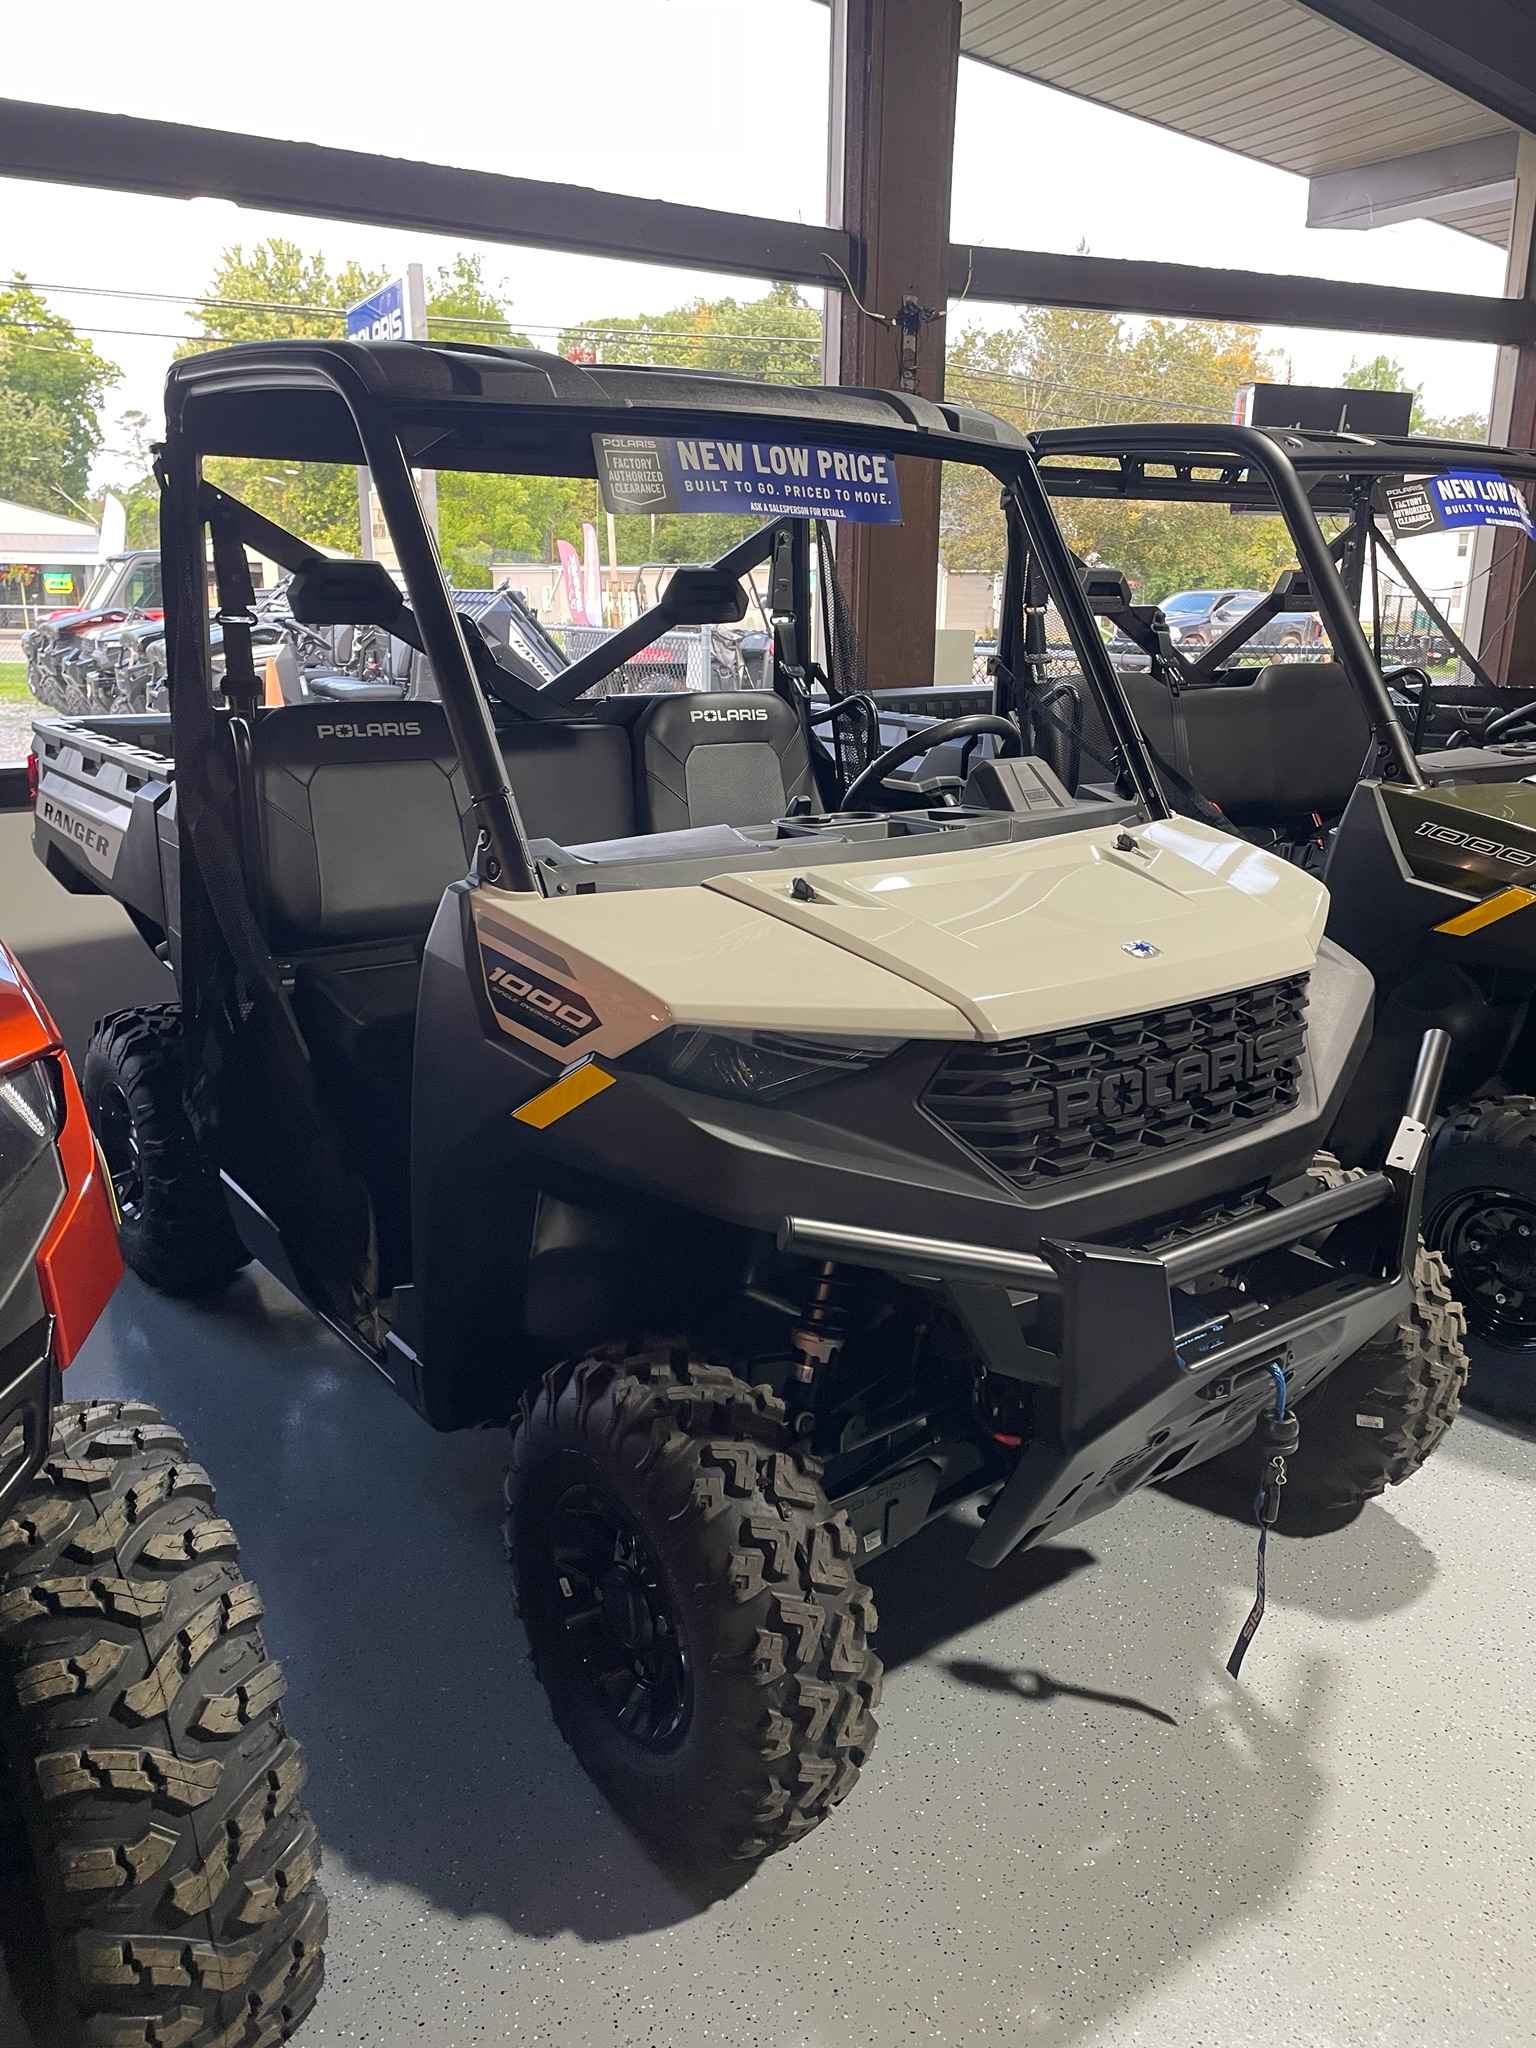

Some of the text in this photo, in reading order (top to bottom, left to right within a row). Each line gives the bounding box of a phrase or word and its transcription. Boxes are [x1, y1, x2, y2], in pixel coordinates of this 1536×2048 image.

[602, 438, 656, 449] POLARIS
[612, 457, 652, 470] FACTORY
[677, 441, 889, 484] NEW LOW PRICE
[608, 470, 664, 482] AUTHORIZED
[614, 483, 662, 494] CLEARANCE
[684, 480, 892, 505] BUILT TO GO. PRICED TO MOVE.
[1386, 484, 1424, 496] POLARIS
[1436, 479, 1477, 500] NEW
[1476, 480, 1509, 502] LOW
[750, 502, 847, 519] ASK A SALESPERSON FOR DETAILS.
[1393, 504, 1431, 518] AUTHORIZED
[1394, 497, 1422, 510] FACTORY
[1445, 503, 1473, 515] BUILT
[1474, 504, 1485, 513] TO
[1398, 513, 1430, 526] CLEARANCE
[513, 639, 551, 681] RANGE
[690, 708, 768, 722] POLARIS
[317, 722, 421, 739] POLARIS
[44, 802, 109, 857] RANGER
[1415, 822, 1536, 867] 1000
[489, 966, 592, 1028] 1000
[492, 986, 580, 1036] SINGLE OVERHEAD CAM
[1054, 1027, 1290, 1129] POLARIS
